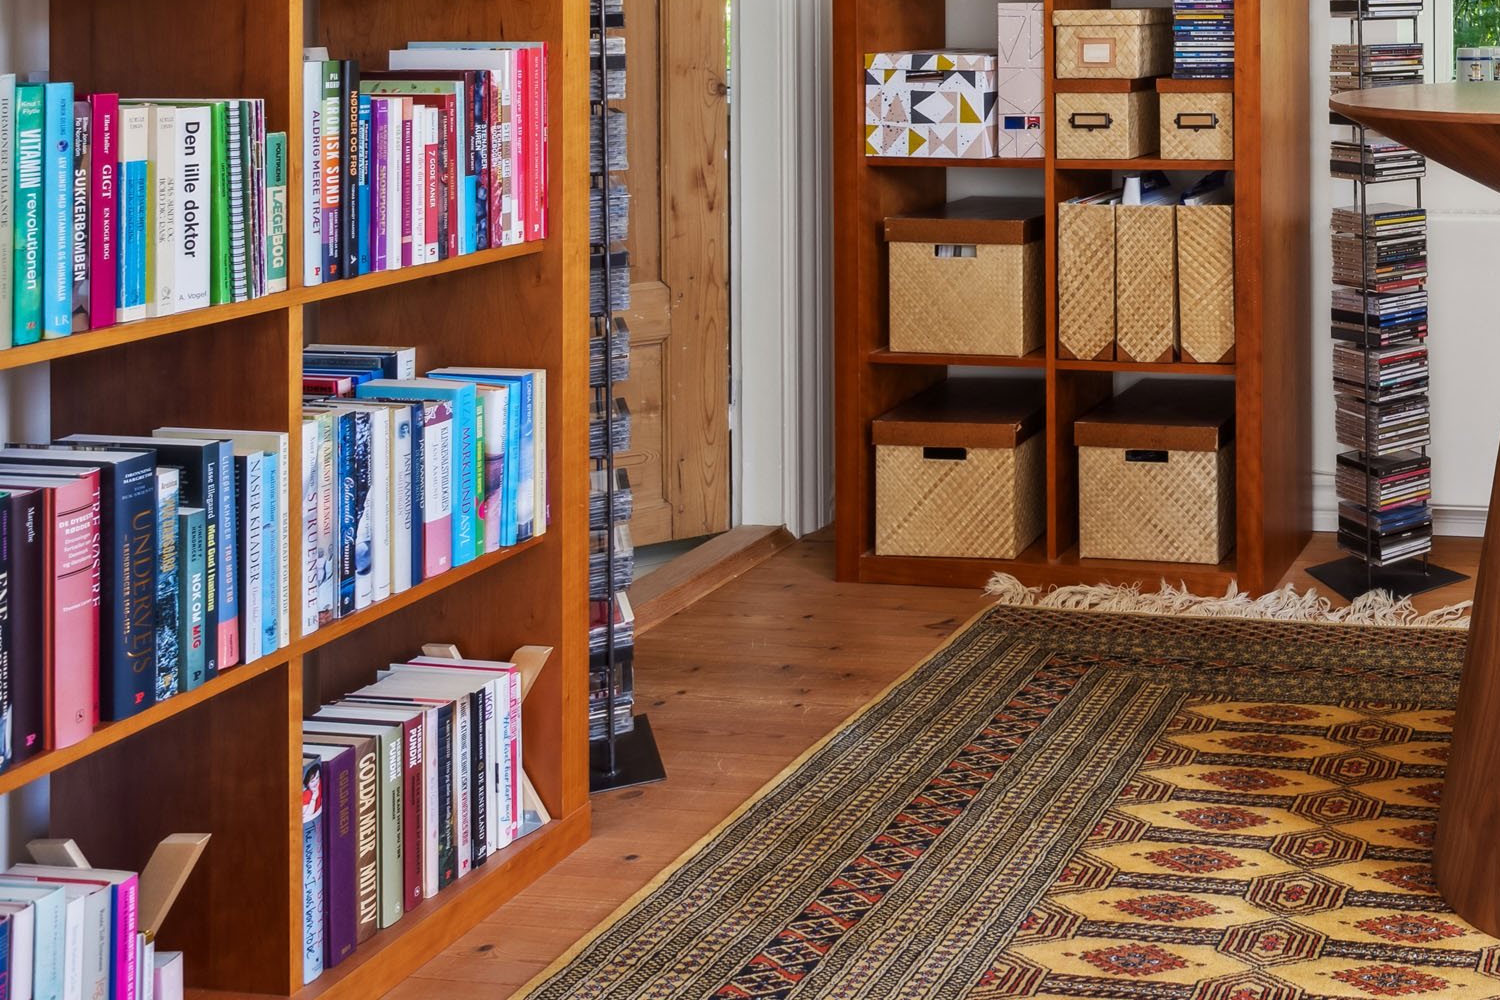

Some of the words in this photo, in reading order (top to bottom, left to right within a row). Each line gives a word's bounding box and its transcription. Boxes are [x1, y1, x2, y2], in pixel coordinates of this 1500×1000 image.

[184, 122, 200, 156] Den
[312, 111, 321, 156] ALDRIG
[326, 97, 339, 161] KRONISK
[350, 137, 357, 153] OG
[20, 129, 41, 188] VITAMIN
[102, 165, 112, 199] GIGT
[184, 164, 200, 193] lille
[312, 160, 321, 195] MERE
[326, 167, 339, 204] SUND
[103, 208, 110, 216] EN
[184, 200, 200, 257] doktor
[272, 190, 284, 268] LÆGEBOG
[312, 199, 321, 235] TRÆT
[27, 193, 38, 289] revolutionen
[207, 463, 216, 482] Lasse
[249, 460, 261, 513] NASER
[461, 427, 471, 514] MARKLUND
[207, 484, 216, 519] Ellegaard
[26, 507, 36, 542] Margrethe
[207, 525, 216, 545] Med
[461, 515, 471, 547] ASYL
[207, 548, 216, 566] Gud
[249, 516, 261, 584] KHADER
[307, 493, 318, 608] STRUENSEE
[127, 510, 152, 673] UNDERVEJS
[191, 573, 202, 601] NOK
[207, 573, 216, 611] hælene
[191, 603, 202, 623] OM
[191, 626, 202, 648] MIG
[409, 729, 417, 768] PUNDIK
[360, 753, 376, 812] GOLDA
[360, 813, 376, 858] MEIR
[360, 865, 376, 897] MIT
[360, 901, 376, 924] LIV
